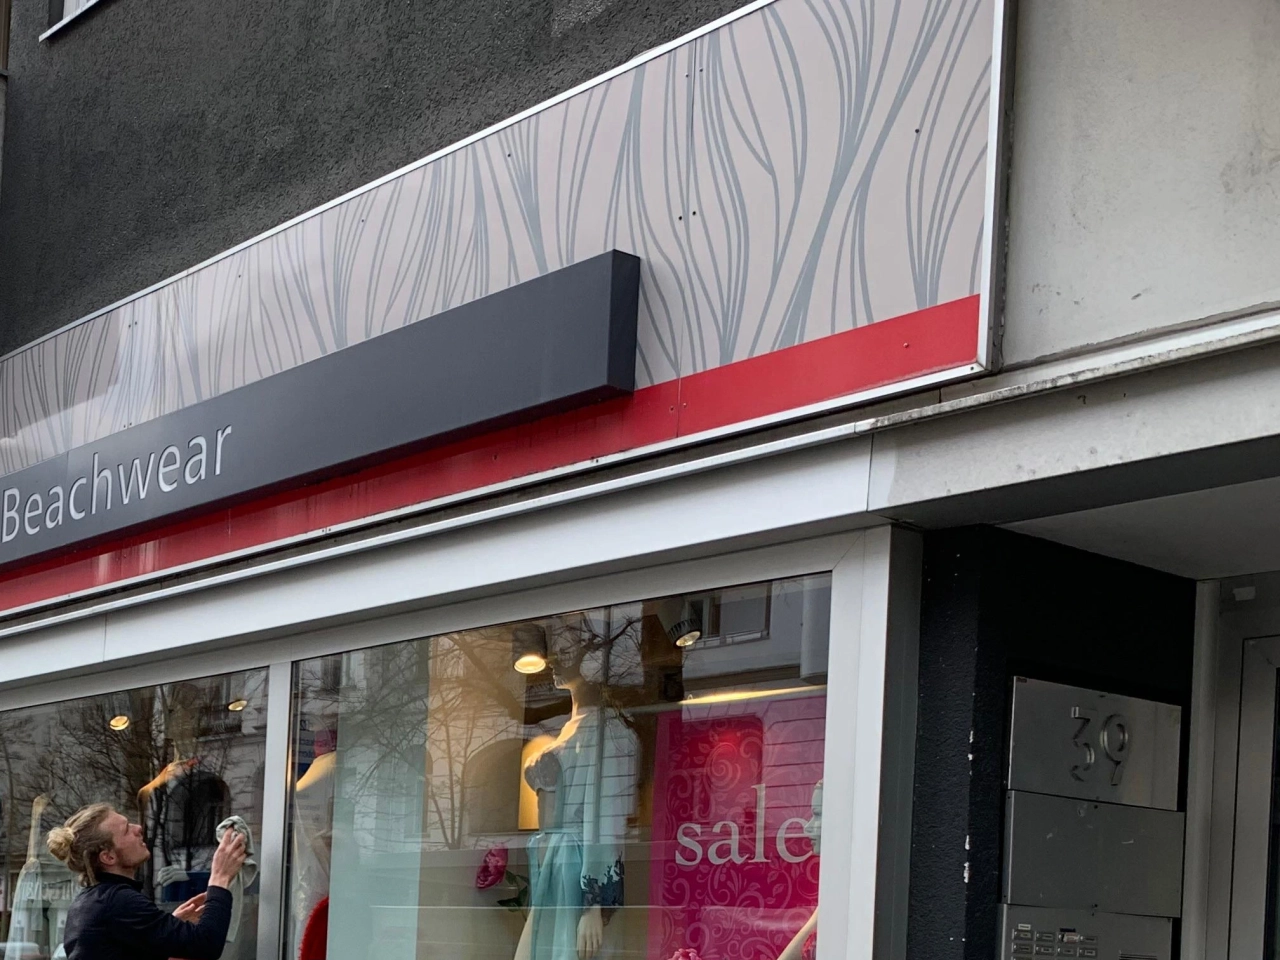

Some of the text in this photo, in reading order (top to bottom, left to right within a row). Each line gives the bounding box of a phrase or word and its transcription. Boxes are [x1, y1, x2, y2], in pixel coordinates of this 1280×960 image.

[1, 423, 233, 544] Beachwear
[1070, 706, 1129, 787] 39
[675, 783, 813, 867] sale
